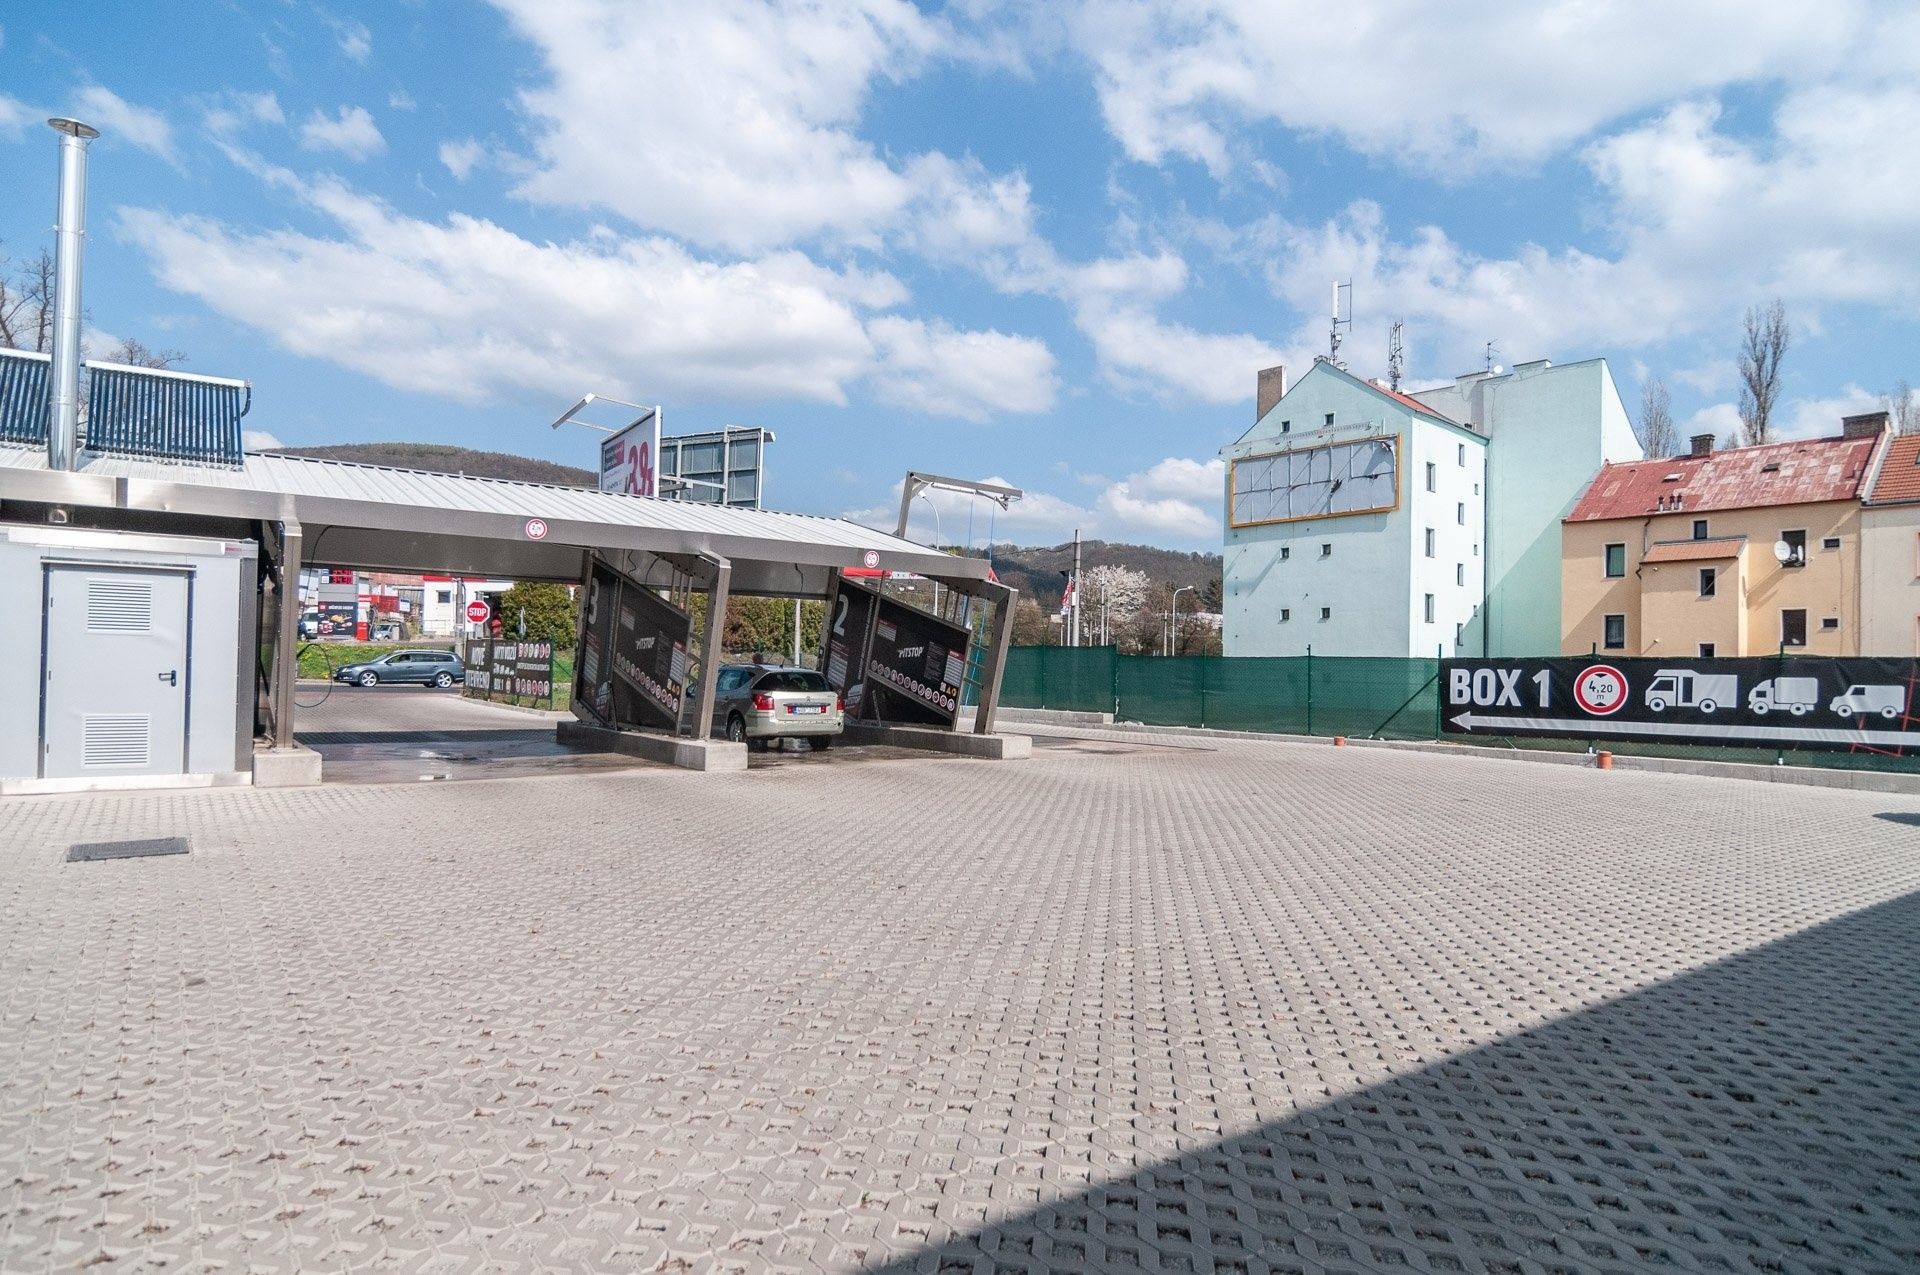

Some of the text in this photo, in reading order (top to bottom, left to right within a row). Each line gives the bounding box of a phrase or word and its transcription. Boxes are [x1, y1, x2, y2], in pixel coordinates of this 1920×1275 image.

[468, 607, 487, 617] STOP
[588, 577, 600, 625] 3
[833, 594, 849, 637] 2
[897, 646, 923, 658] PITSTOP
[1450, 668, 1550, 708] BOX 1
[1589, 680, 1613, 693] 4,20
